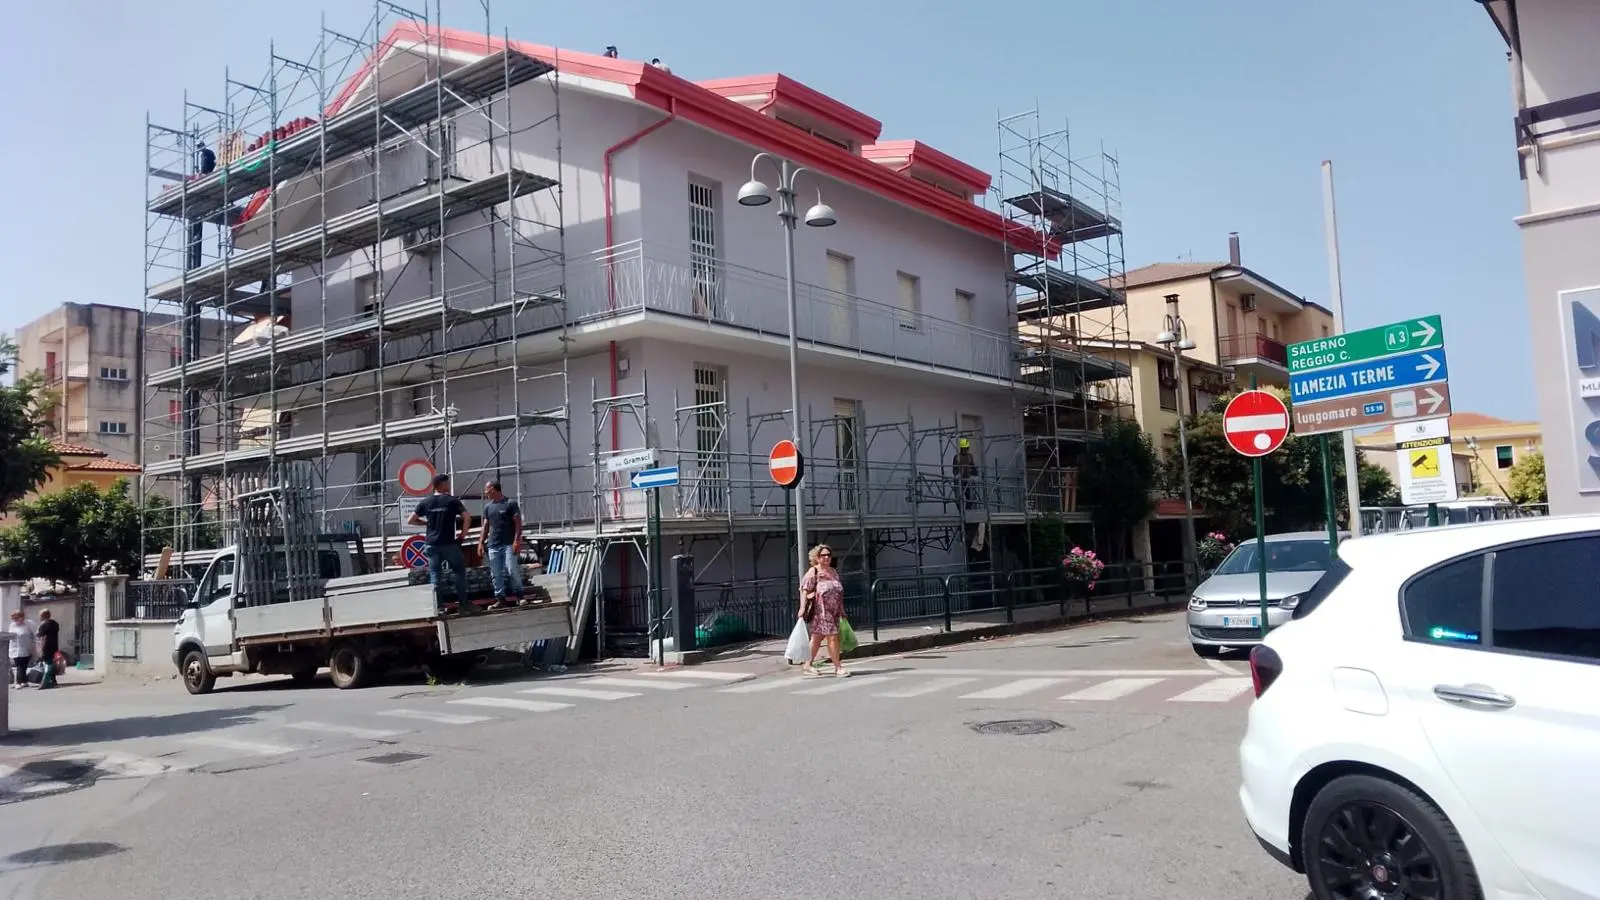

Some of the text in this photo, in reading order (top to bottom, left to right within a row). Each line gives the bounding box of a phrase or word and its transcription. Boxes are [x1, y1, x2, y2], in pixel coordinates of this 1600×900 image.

[1291, 337, 1346, 356] SALERNO
[1388, 330, 1406, 346] A 3
[1292, 350, 1351, 370] REGGIO C.
[1294, 365, 1395, 396] LAMEZIA TERME
[1297, 407, 1357, 424] lungomare
[1401, 437, 1445, 449] ATTENZIONE!
[623, 453, 650, 465] Gramsci
